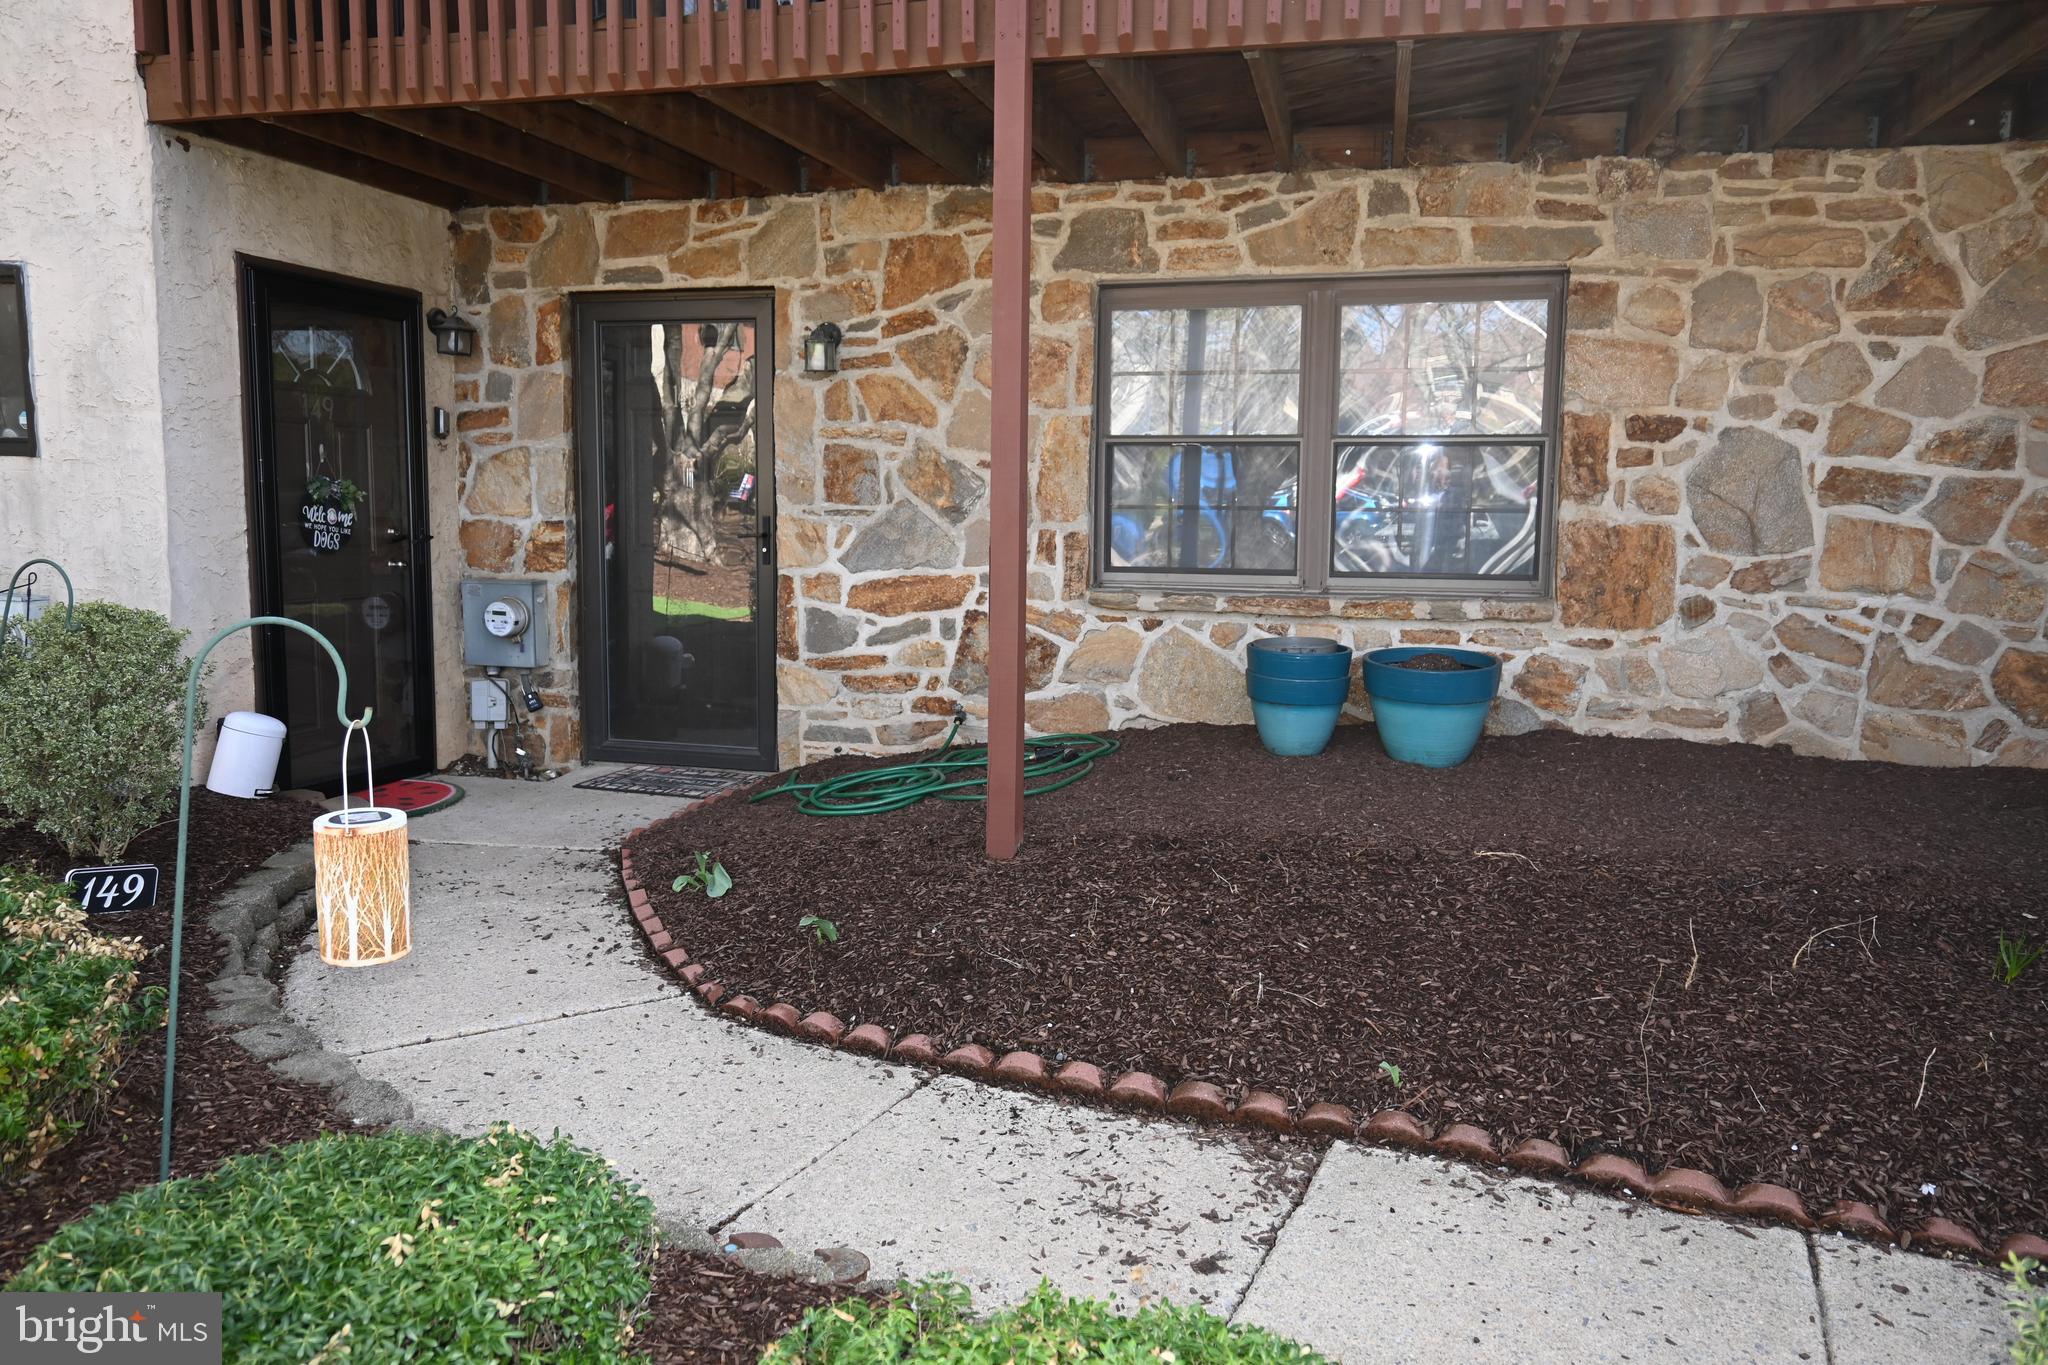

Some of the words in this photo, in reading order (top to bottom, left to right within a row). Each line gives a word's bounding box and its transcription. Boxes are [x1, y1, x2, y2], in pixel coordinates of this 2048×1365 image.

[302, 393, 334, 420] 149
[314, 523, 327, 531] HOPE
[314, 530, 340, 550] DOGS
[82, 873, 145, 910] 149
